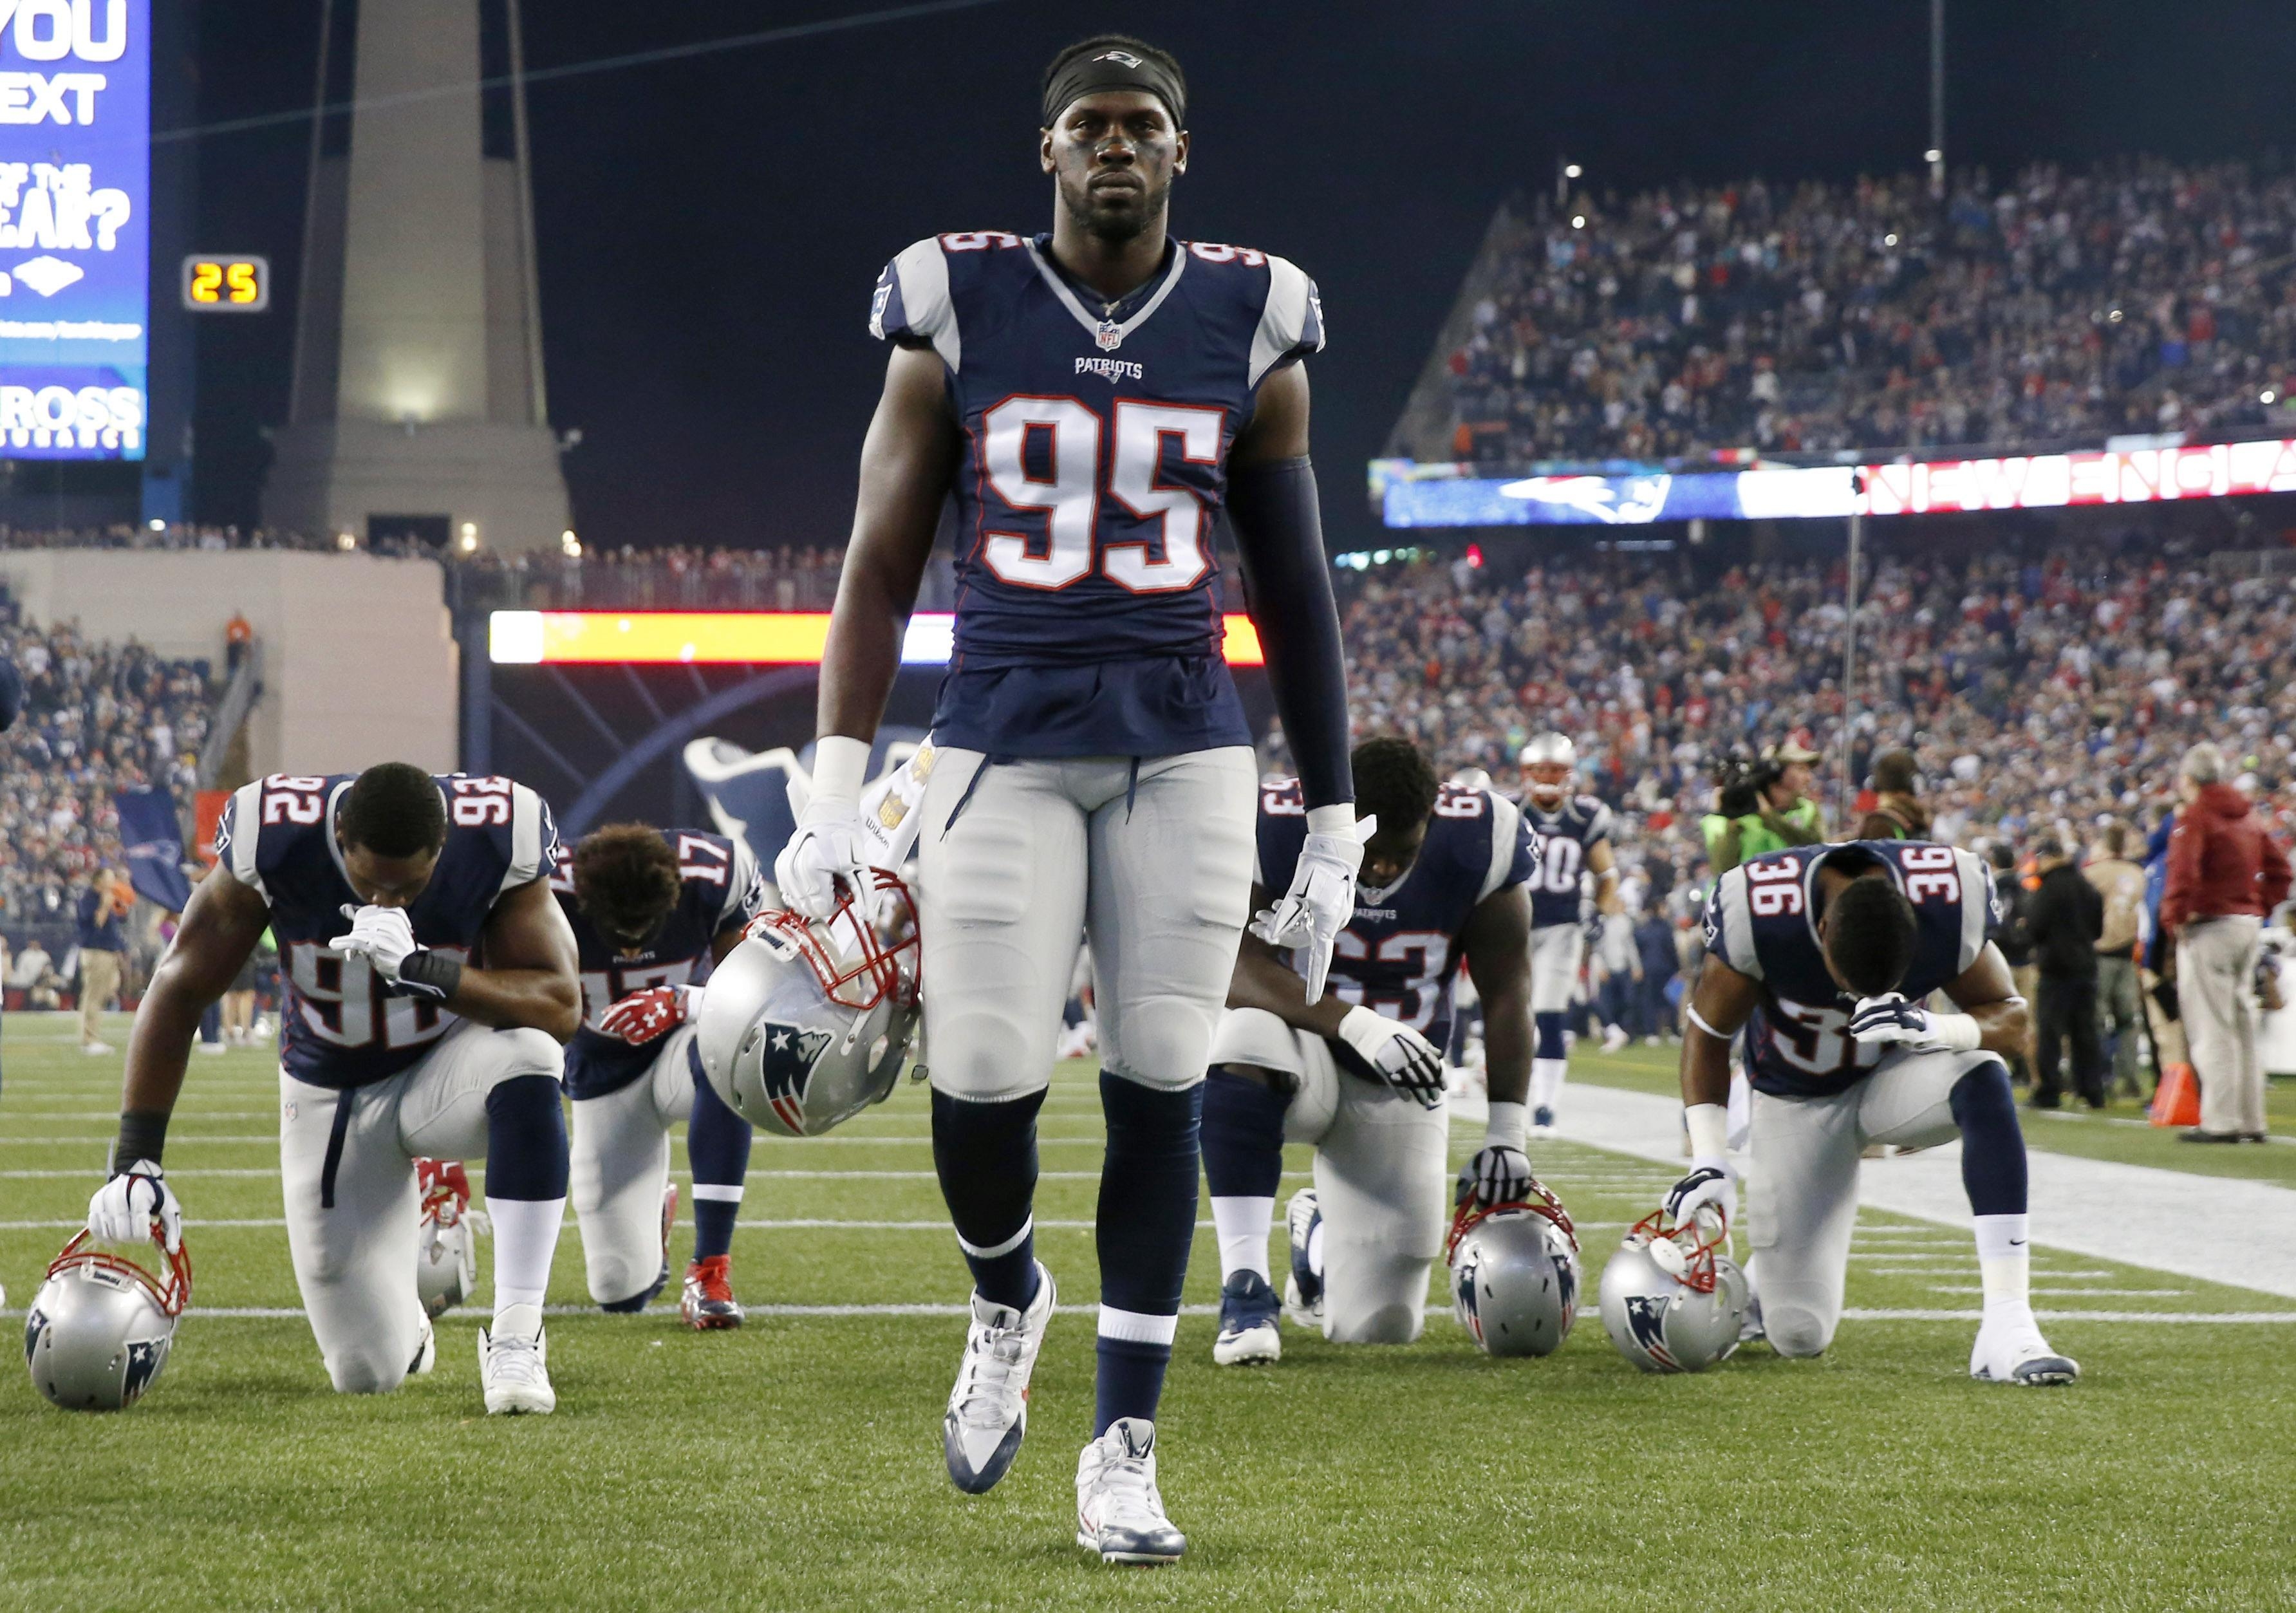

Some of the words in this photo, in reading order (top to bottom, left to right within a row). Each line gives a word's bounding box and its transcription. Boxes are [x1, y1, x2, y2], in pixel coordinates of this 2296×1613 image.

[191, 262, 257, 303] 25
[1099, 332, 1119, 346] NFL
[1075, 357, 1143, 380] PATRIOTS
[982, 393, 1227, 595] 95
[263, 772, 328, 826] 92
[677, 834, 730, 886] 17
[1746, 855, 1804, 917] 36
[1899, 846, 1961, 905] 36
[1772, 998, 1883, 1074] 3
